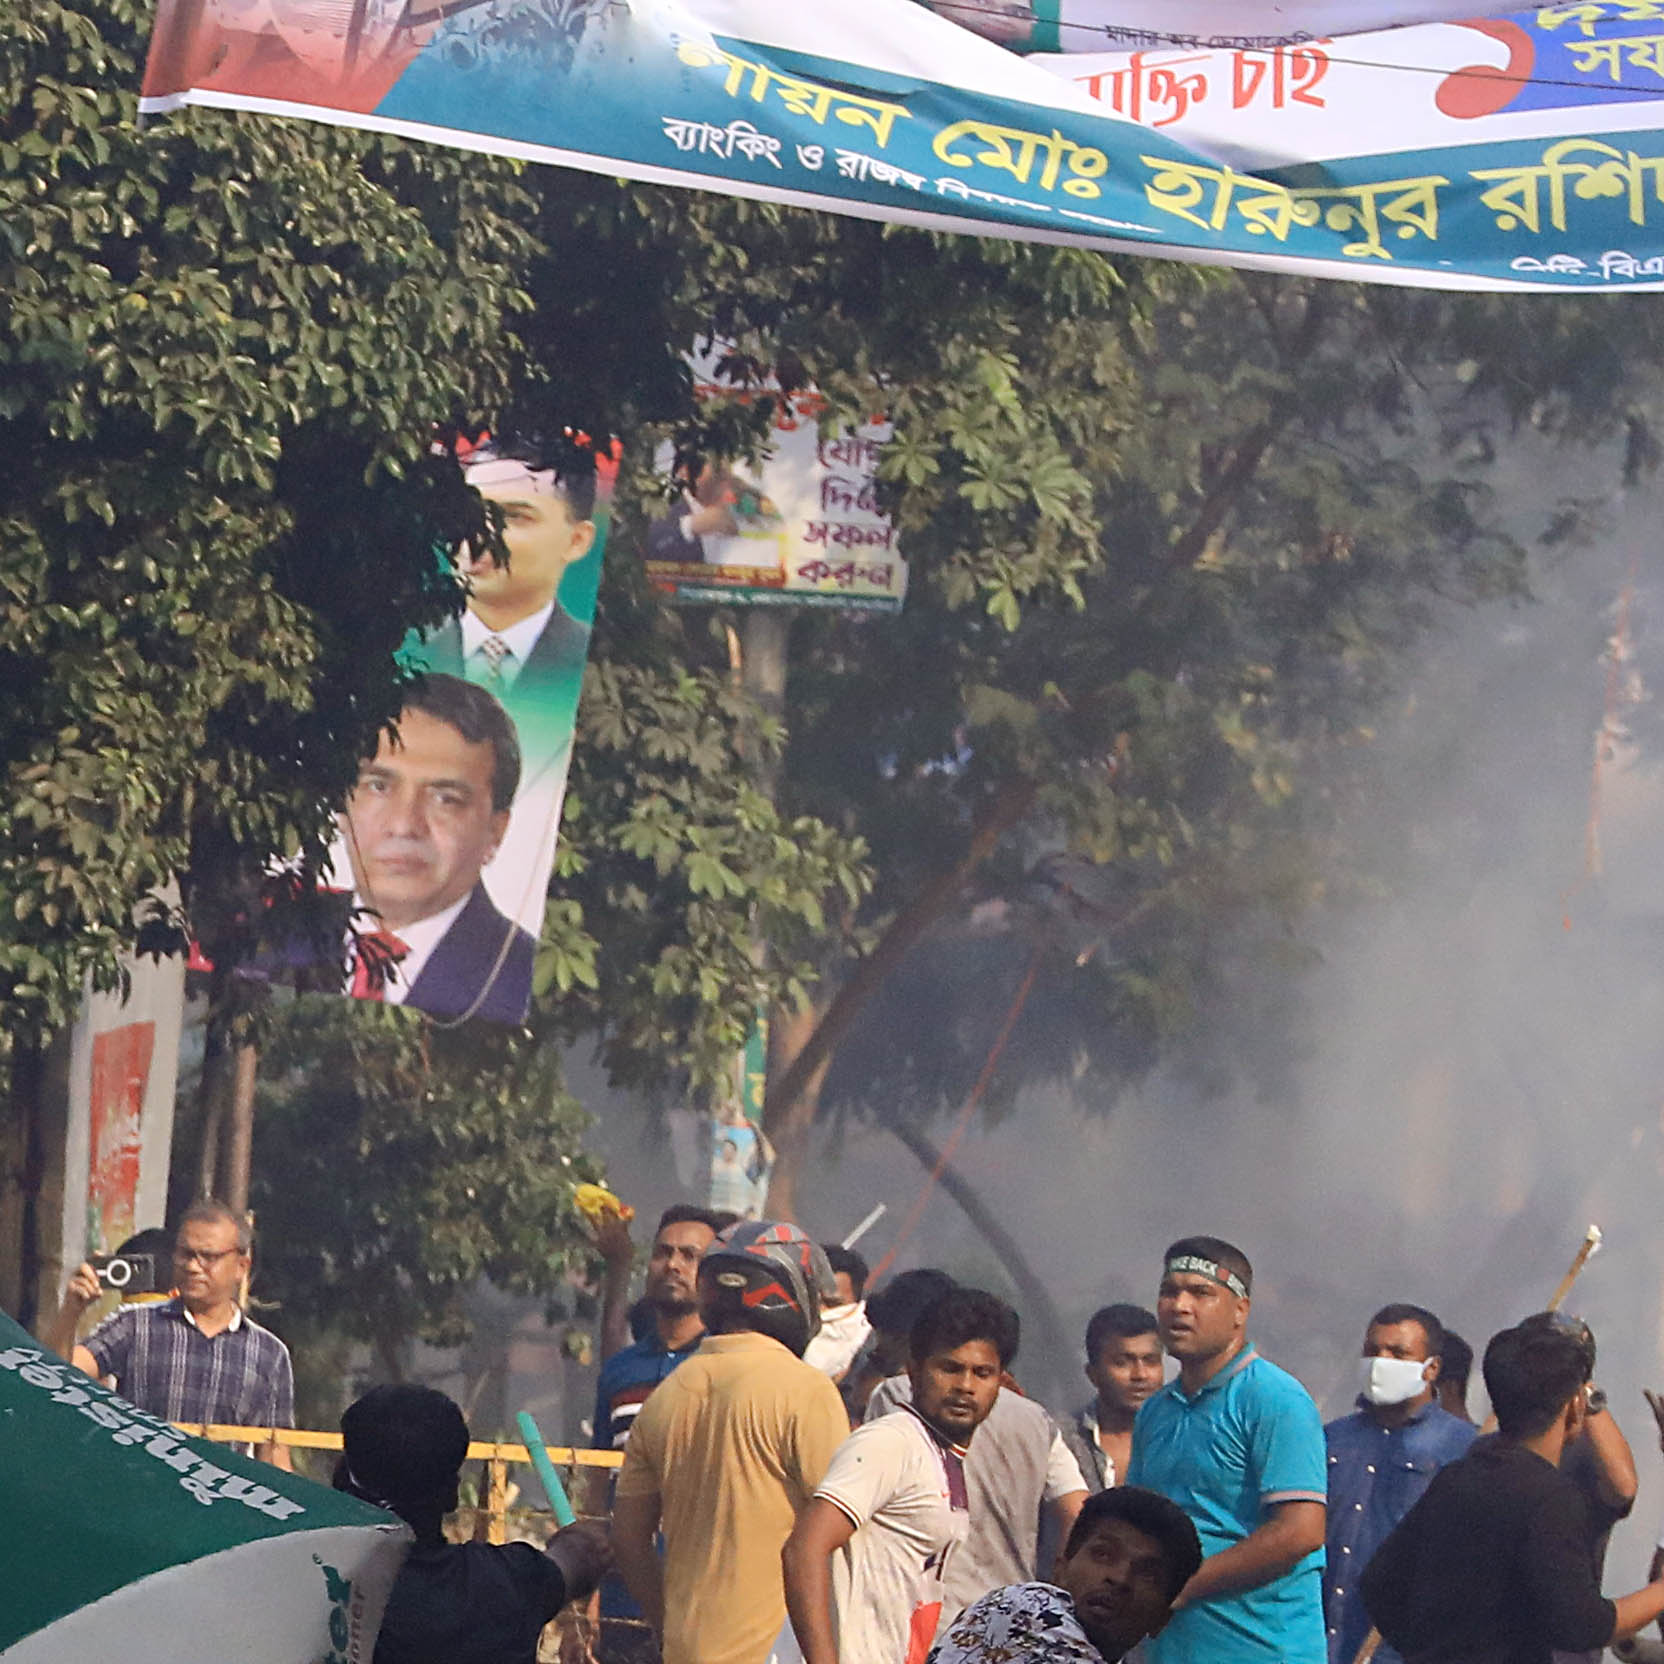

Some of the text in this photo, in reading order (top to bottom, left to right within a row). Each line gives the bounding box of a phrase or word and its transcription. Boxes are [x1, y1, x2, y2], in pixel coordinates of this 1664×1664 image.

[661, 117, 783, 169] ব্যাংকিং
[795, 143, 825, 171] ও
[932, 119, 1108, 199] মোঃ
[1140, 153, 1449, 259] হারুনুর
[1468, 138, 1664, 234] রশি
